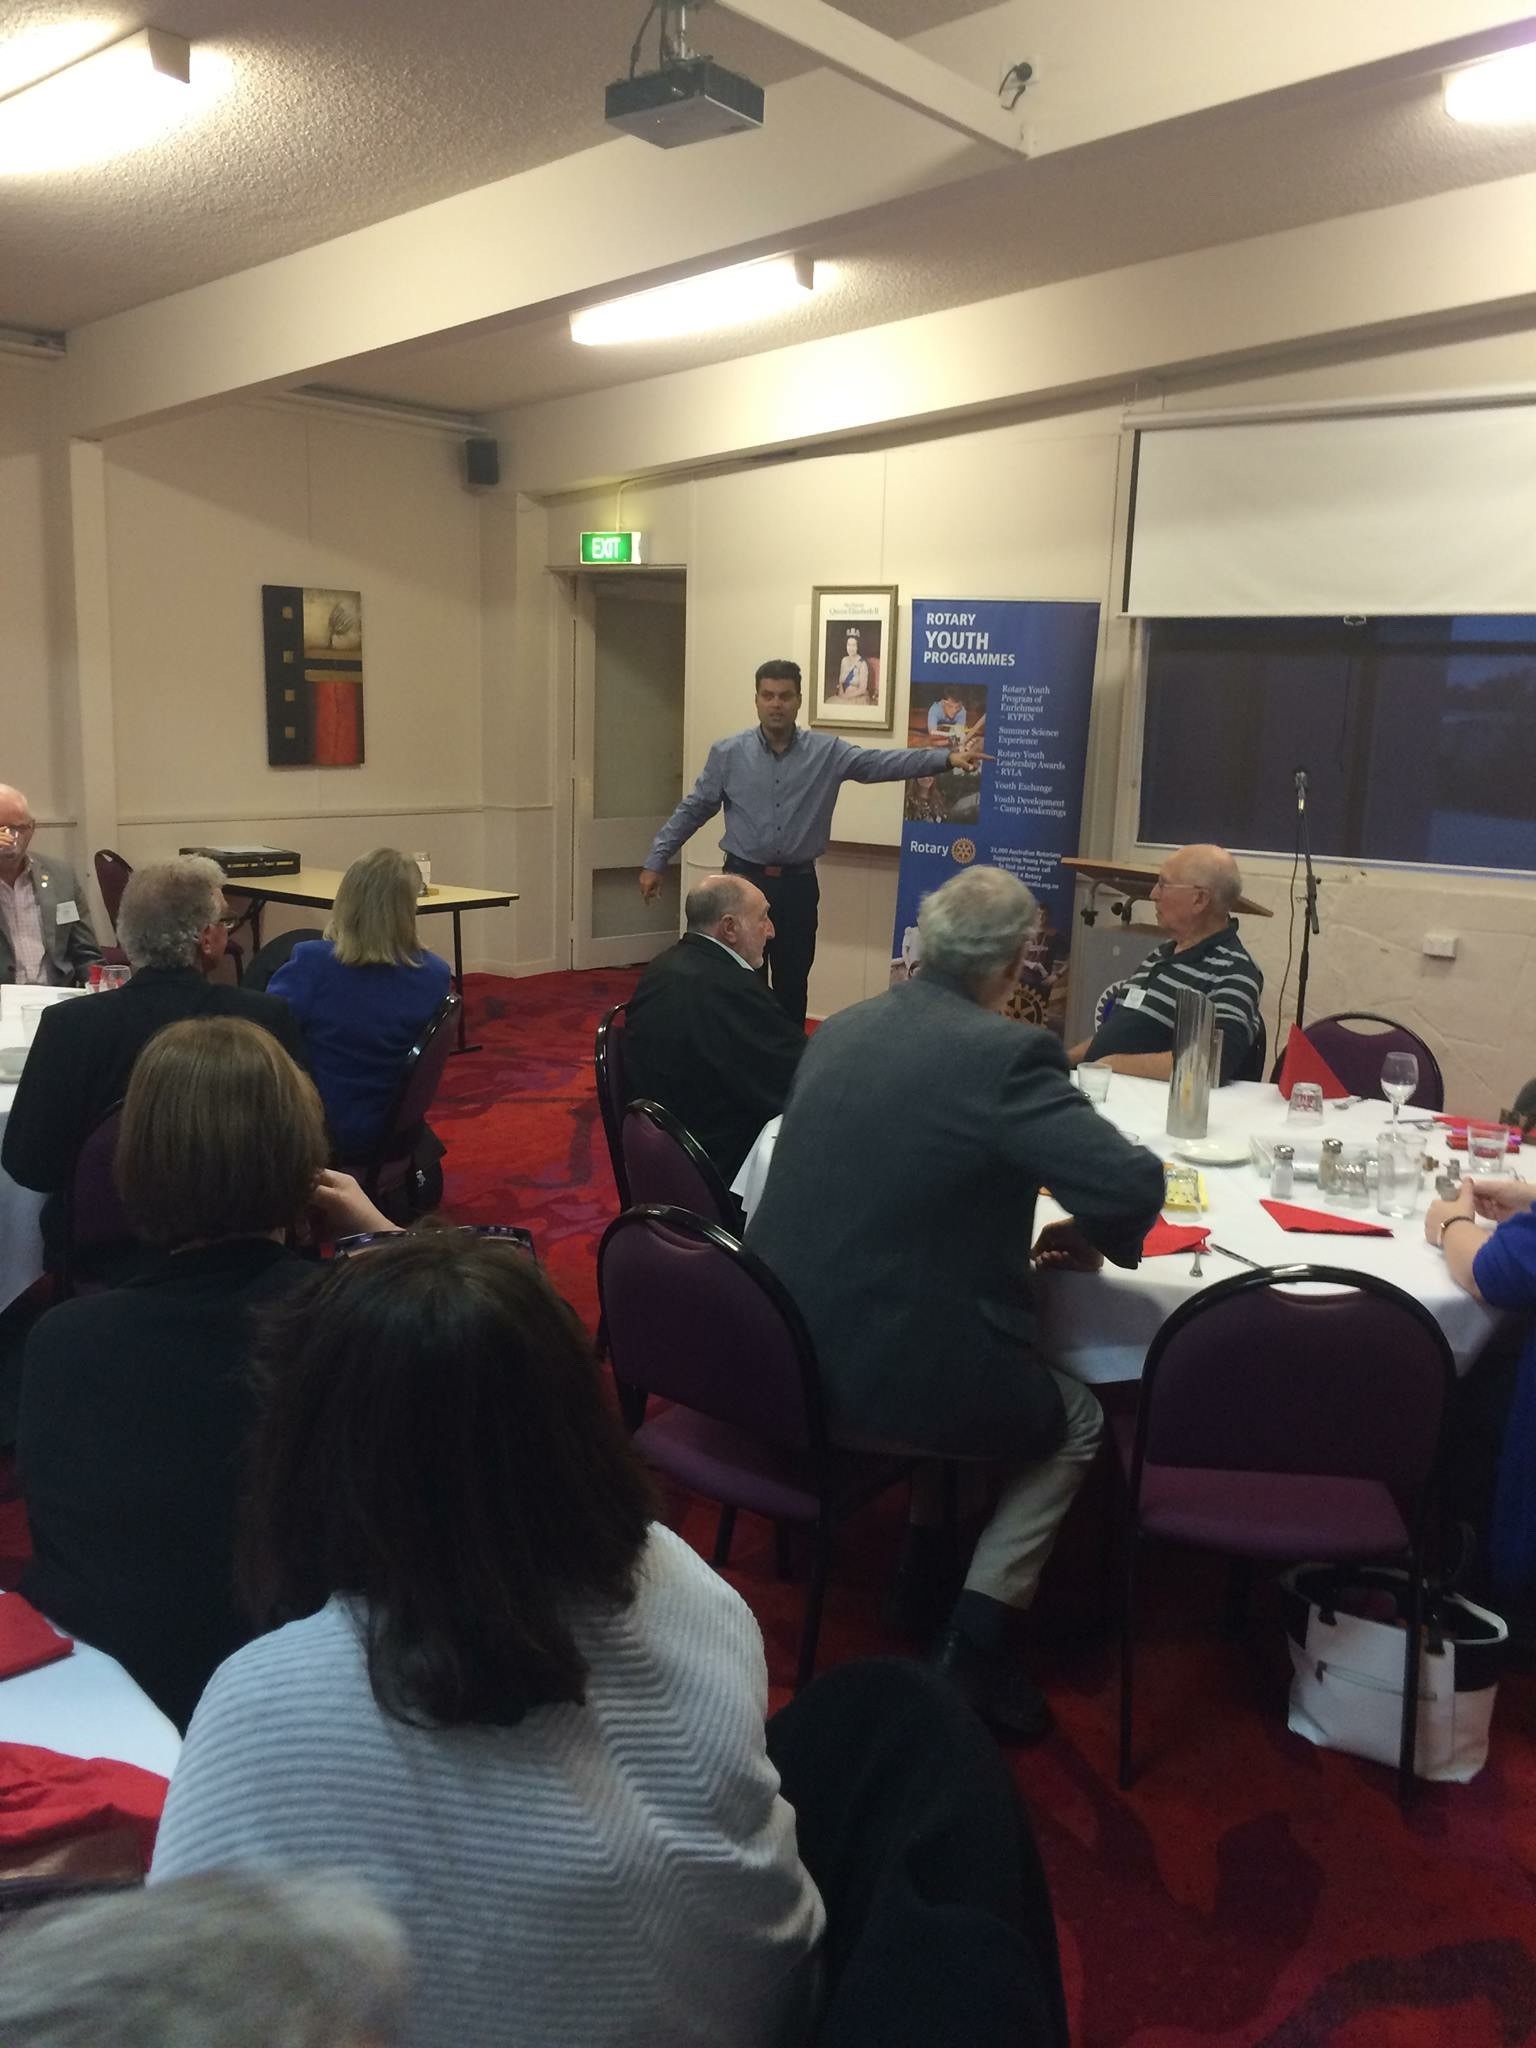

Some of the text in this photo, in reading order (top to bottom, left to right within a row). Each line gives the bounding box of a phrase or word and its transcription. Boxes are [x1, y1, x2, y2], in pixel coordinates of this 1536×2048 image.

[592, 537, 621, 559] EXIT
[926, 612, 976, 626] ROTARY
[925, 630, 989, 650] YOUTH
[924, 651, 1016, 667] PROGRAMMES
[1002, 685, 1050, 695] Rotary Youth
[1001, 694, 1042, 704] Program of
[1000, 703, 1044, 713] Enrichment
[1007, 712, 1034, 721] RYPEN
[999, 727, 1060, 737] Summer Science
[998, 735, 1039, 745] Experience
[997, 749, 1045, 760] Rotary Youth
[996, 758, 1066, 770] Leadership Awards
[1001, 767, 1022, 776] RYLA
[994, 780, 1053, 794] Youth Exchange
[993, 794, 1065, 808] Youth Development
[1000, 804, 1022, 815] Camp
[1023, 806, 1067, 818] Awakenings
[910, 840, 949, 857] Rotary
